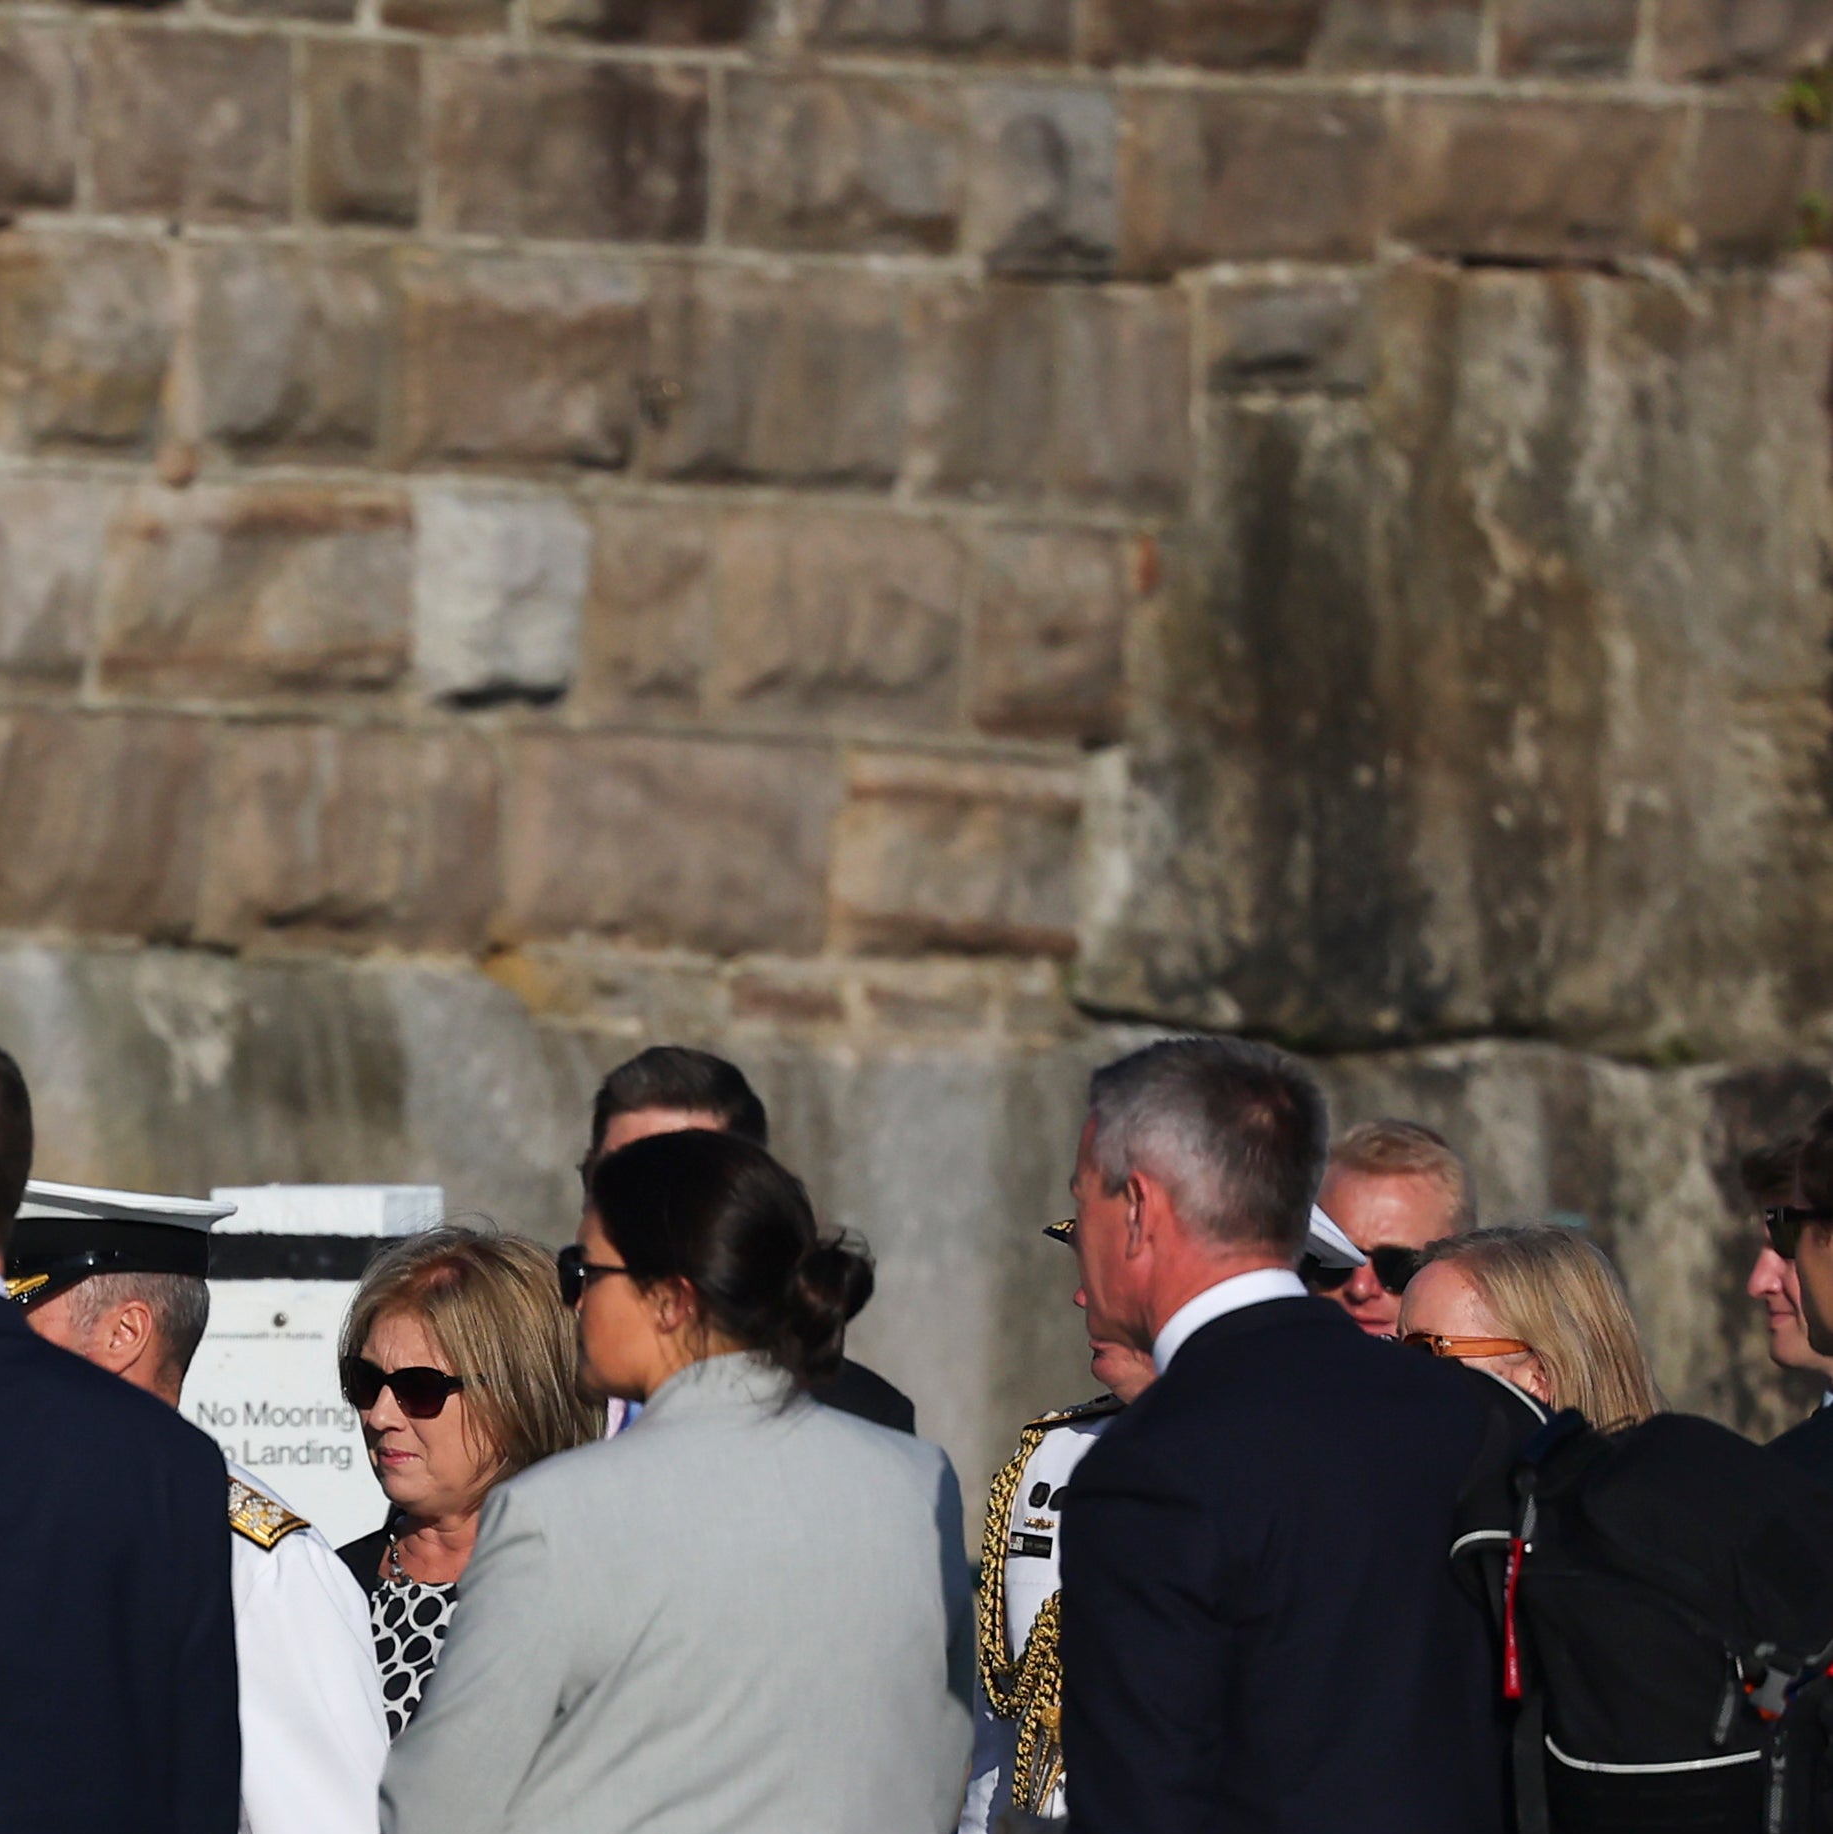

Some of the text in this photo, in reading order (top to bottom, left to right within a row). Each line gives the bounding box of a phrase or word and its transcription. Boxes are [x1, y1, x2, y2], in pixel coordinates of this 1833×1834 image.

[196, 1400, 357, 1433] No Mooring
[242, 1438, 354, 1471] Landing
